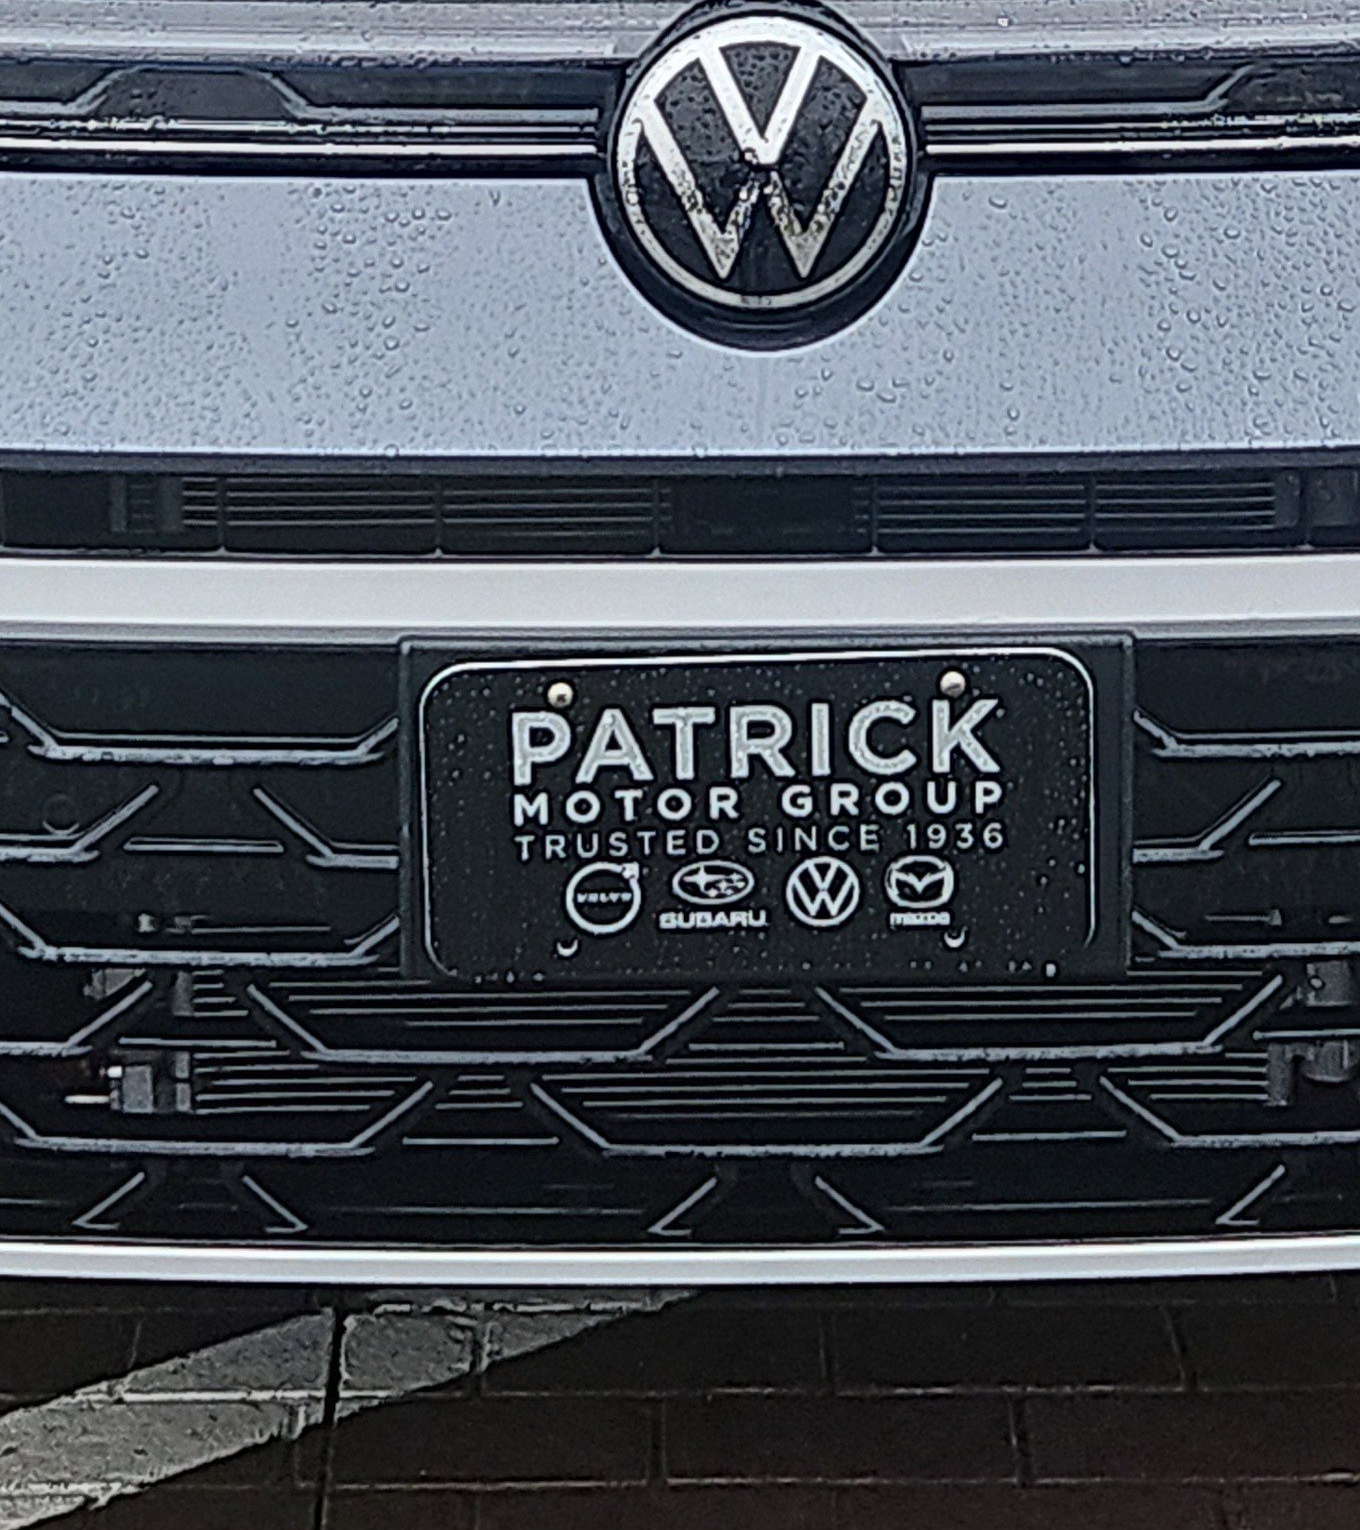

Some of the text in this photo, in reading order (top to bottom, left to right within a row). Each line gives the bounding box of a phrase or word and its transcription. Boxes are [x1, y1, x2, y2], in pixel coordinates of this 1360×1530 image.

[512, 699, 1001, 786] PATRICK
[514, 781, 1003, 826] MOTOR GROUP
[514, 823, 1004, 861] TRUSTED SINCE 1936
[658, 910, 769, 930] SUBARU
